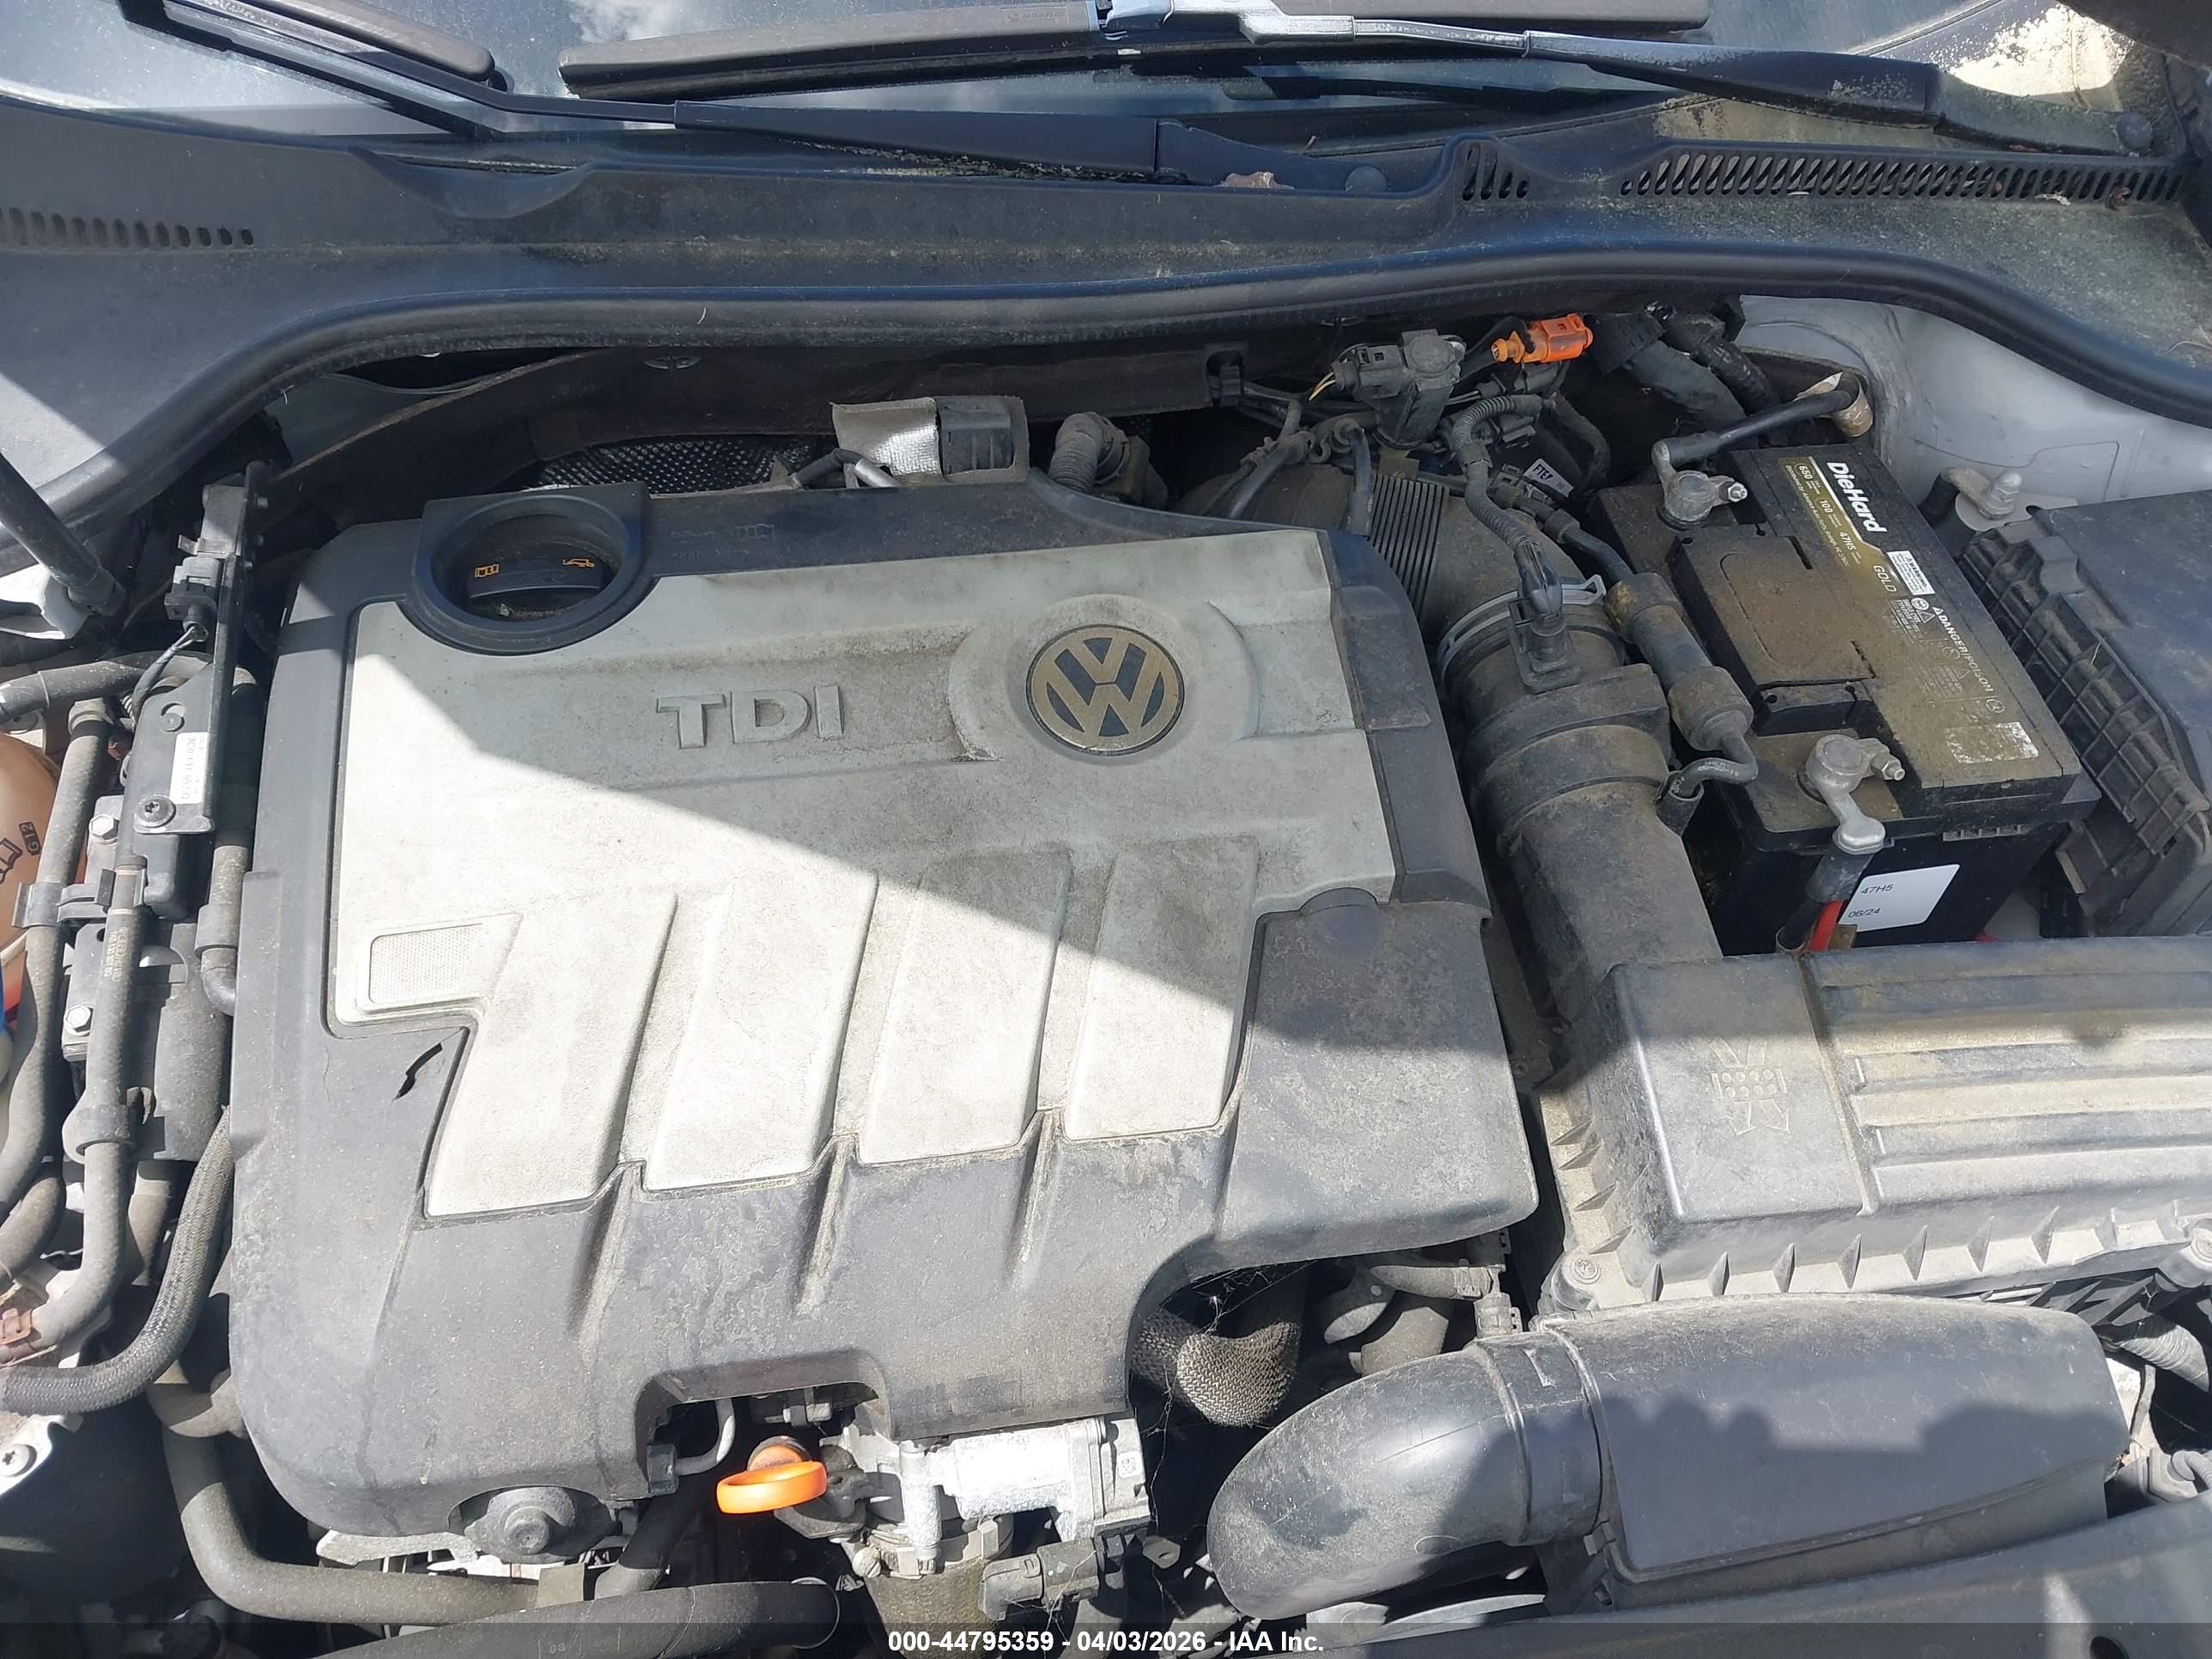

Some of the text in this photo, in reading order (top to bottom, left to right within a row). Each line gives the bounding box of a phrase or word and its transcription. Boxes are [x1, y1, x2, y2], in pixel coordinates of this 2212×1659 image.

[1799, 465, 1814, 479] 650
[1826, 462, 1888, 532] DieHard
[1820, 500, 1833, 513] 100
[1839, 532, 1856, 550] 47H5
[1874, 565, 1897, 592] GOLD
[657, 686, 844, 750] TDI
[21, 823, 40, 852] G12
[1860, 884, 1895, 895] 47H5
[1847, 907, 1881, 919] 06/24
